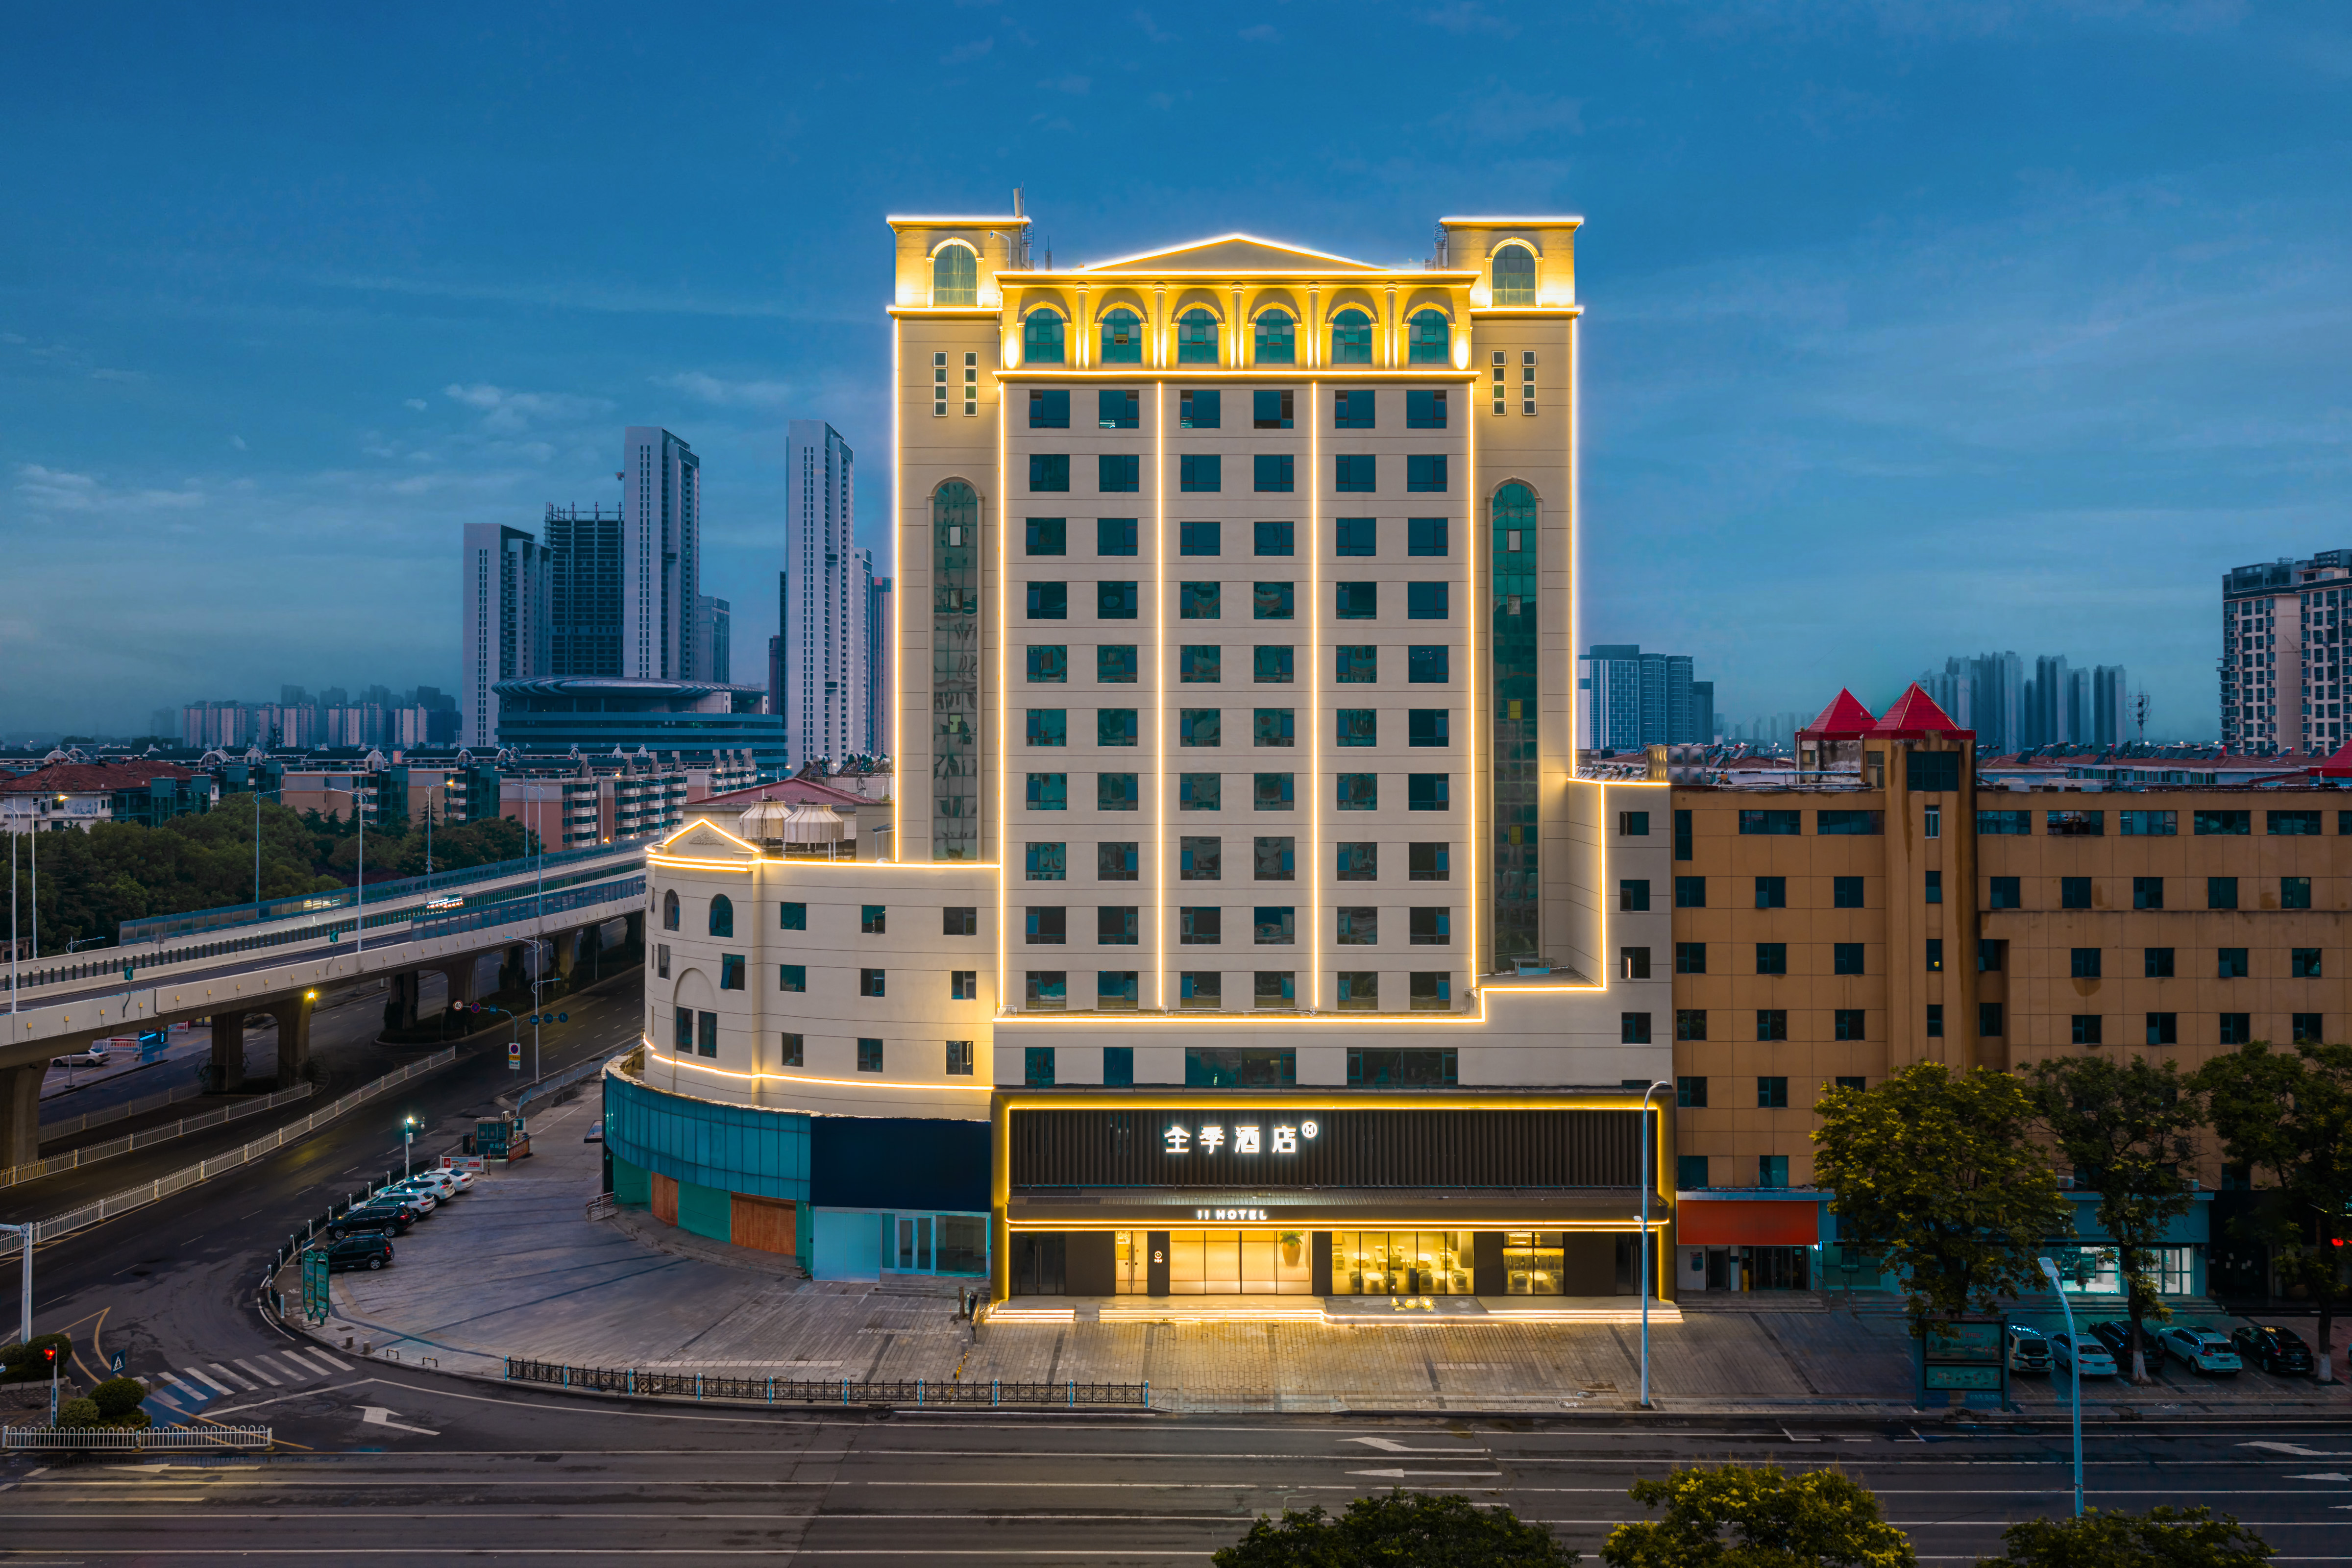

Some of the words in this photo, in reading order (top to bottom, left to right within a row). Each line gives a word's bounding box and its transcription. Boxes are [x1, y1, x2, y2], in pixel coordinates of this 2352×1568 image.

[1164, 1125, 1296, 1153] 全季酒店
[1197, 1210, 1209, 1220] JI
[1215, 1210, 1267, 1220] HOTEL
